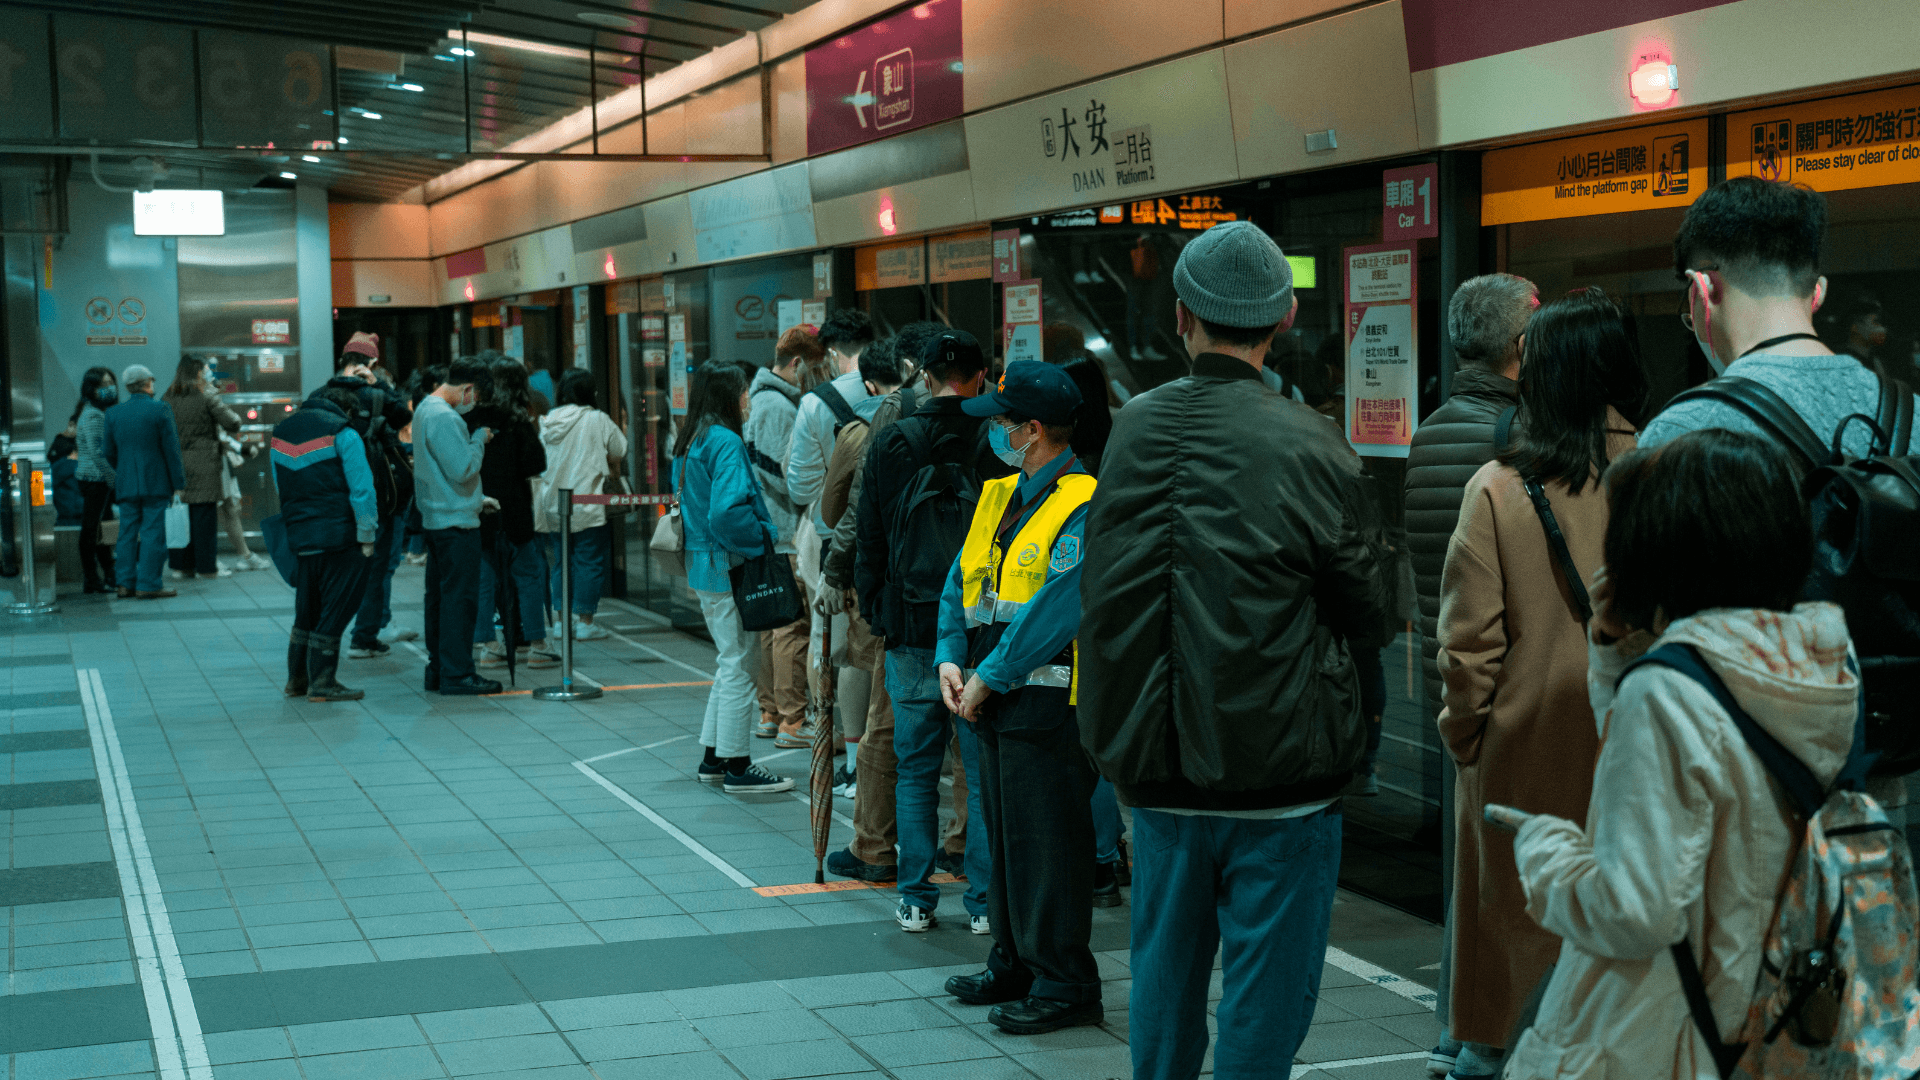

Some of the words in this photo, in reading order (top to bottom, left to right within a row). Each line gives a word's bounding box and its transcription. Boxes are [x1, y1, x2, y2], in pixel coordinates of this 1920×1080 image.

[882, 62, 903, 96] 象山
[878, 98, 910, 119] Xiangshan
[1058, 99, 1109, 162] 大安
[1796, 106, 1920, 152] 關門時勿強行
[1113, 132, 1151, 166] 二月台
[1557, 145, 1647, 180] 小心月台間隙
[1796, 157, 1831, 172] Please
[1833, 153, 1856, 170] stay
[1858, 149, 1885, 165] clear
[1888, 145, 1899, 162] of
[1902, 144, 1920, 160] clo
[1073, 168, 1106, 193] DAAN
[1116, 168, 1148, 186] Platform
[1149, 165, 1155, 181] 2
[1555, 185, 1575, 199] Mind
[1577, 184, 1591, 197] the
[1592, 179, 1628, 198] platform
[1630, 178, 1648, 194] gap
[1386, 178, 1414, 208] 車廂
[1418, 176, 1430, 224] 1
[1398, 212, 1415, 228] Car
[745, 586, 784, 601] OWNDAYS
